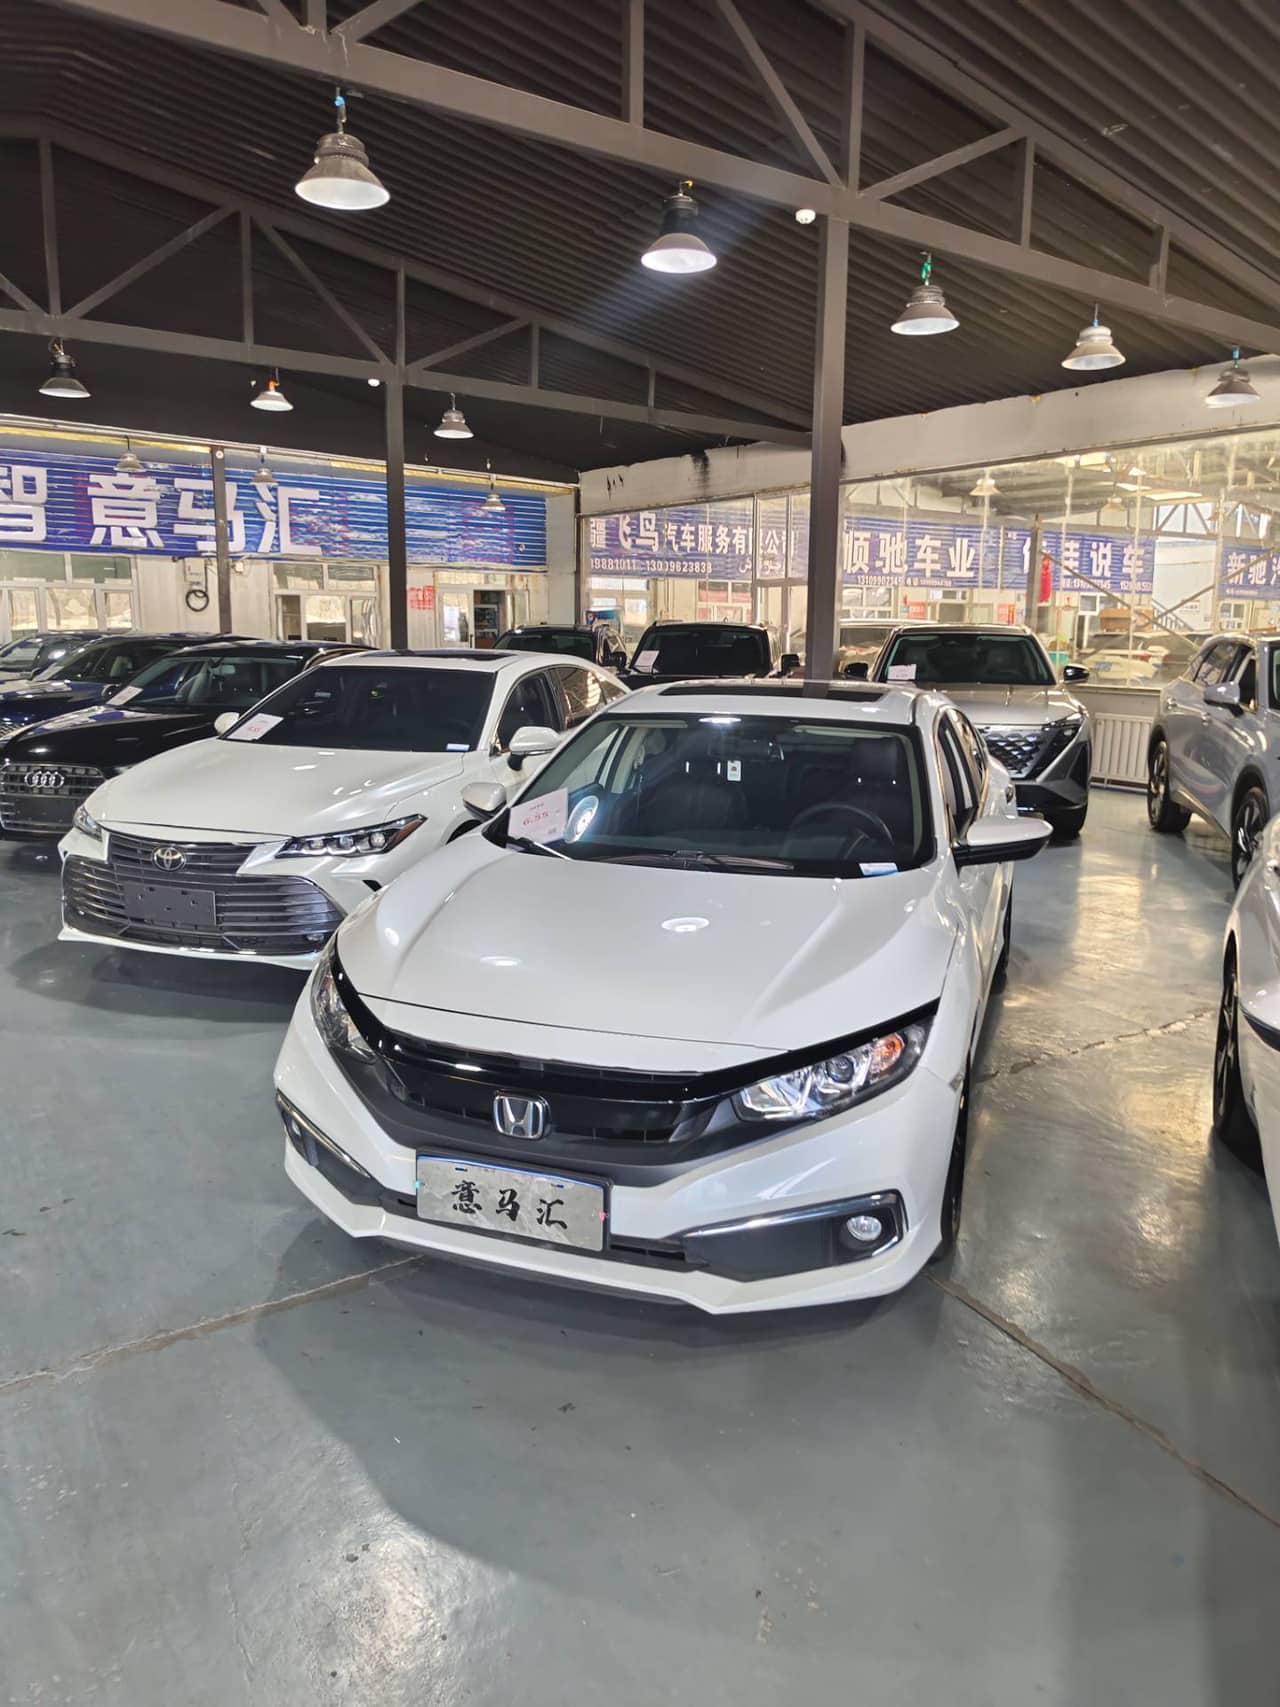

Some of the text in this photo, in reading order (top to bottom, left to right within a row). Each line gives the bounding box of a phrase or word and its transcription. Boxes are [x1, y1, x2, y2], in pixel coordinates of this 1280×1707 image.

[87, 472, 322, 555] 意马汇
[843, 529, 976, 578] 顺驰车业
[451, 1178, 567, 1232] 意马汇
